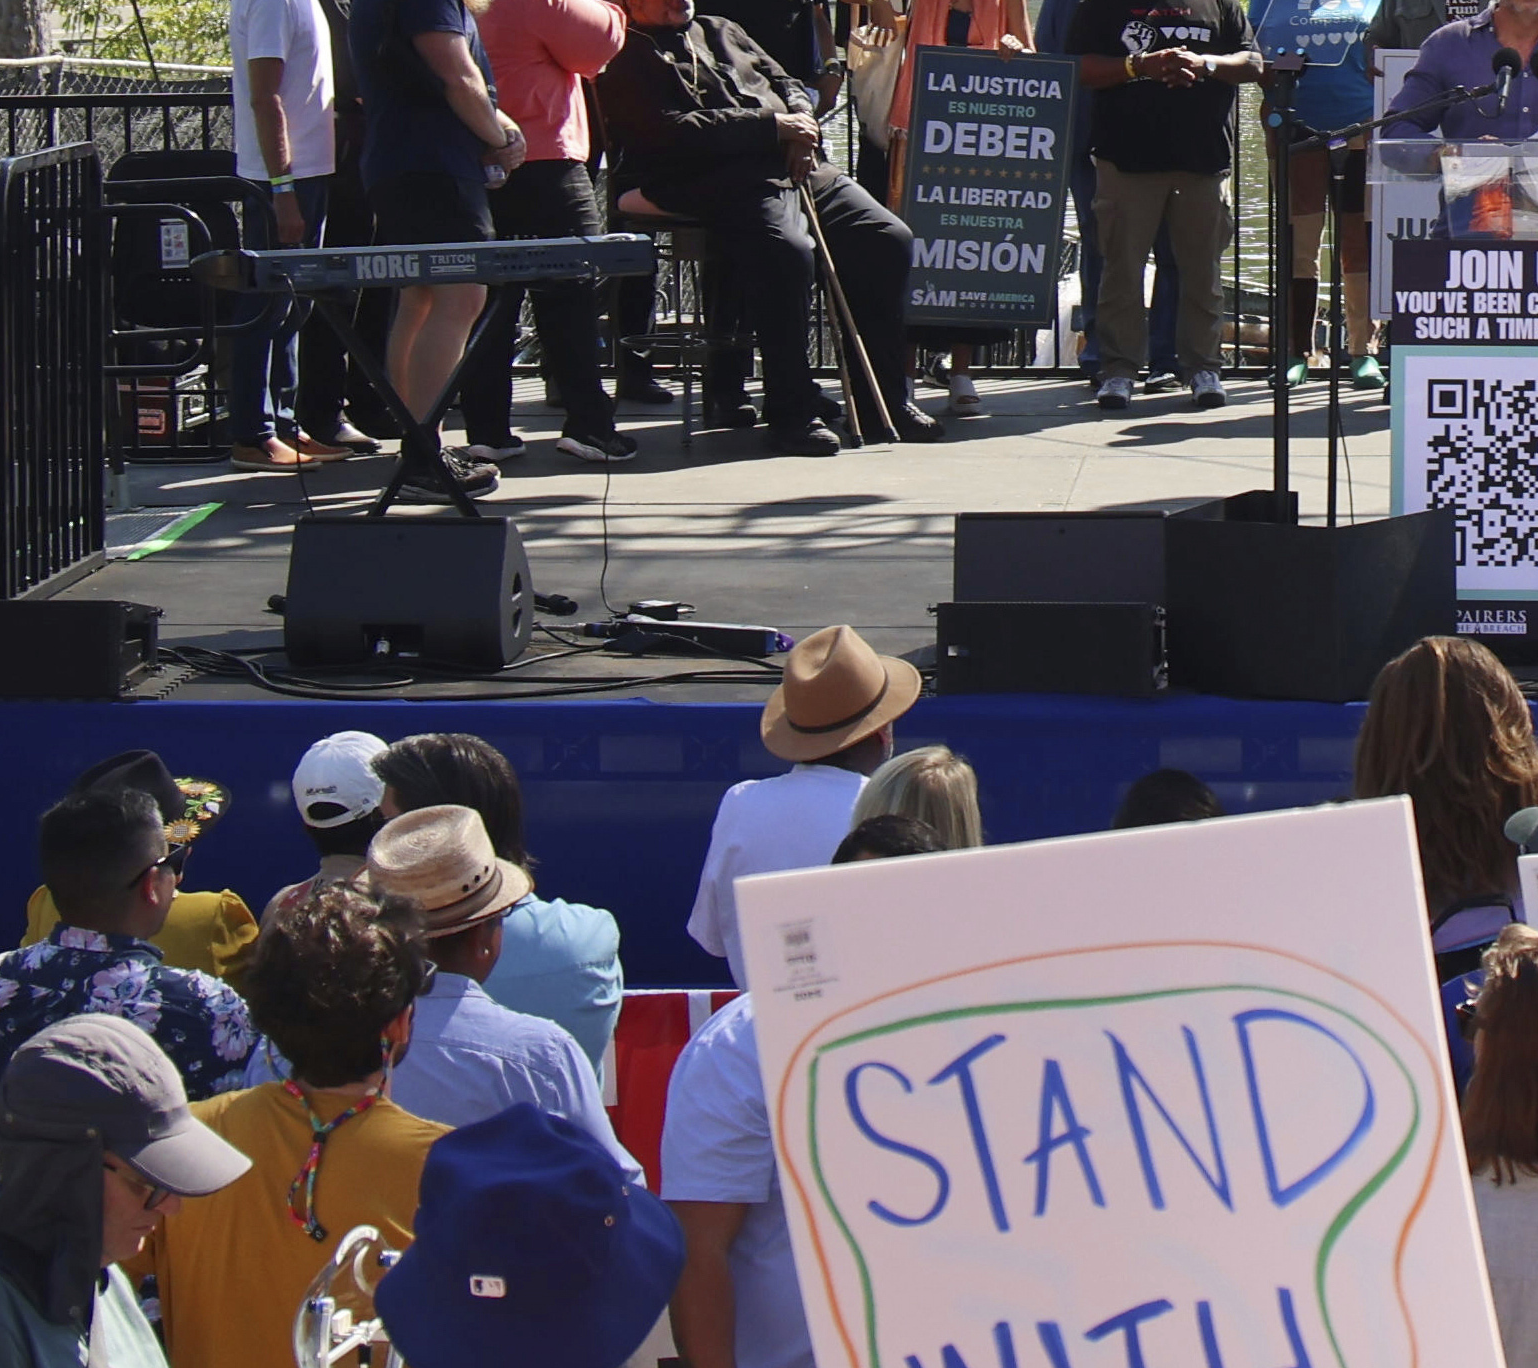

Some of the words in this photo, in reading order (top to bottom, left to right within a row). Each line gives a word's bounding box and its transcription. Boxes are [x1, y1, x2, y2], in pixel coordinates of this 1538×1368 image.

[1160, 27, 1211, 43] VOTE
[928, 72, 956, 95] LA
[961, 74, 1062, 100] JUSTICIA
[948, 101, 967, 115] ES
[969, 102, 1036, 118] NUESTRO
[923, 120, 1056, 161] DEBER
[916, 185, 943, 204] LA
[948, 187, 1052, 210] LIBERTAD
[940, 214, 958, 228] ES
[961, 215, 1024, 231] NUESTRA
[911, 234, 1045, 274] MISIÓN
[355, 254, 419, 280] KORG
[430, 254, 476, 265] TRITON
[1445, 250, 1524, 290] JOIN
[911, 288, 957, 307] SAM
[959, 292, 987, 301] SAVE
[988, 293, 1035, 303] AMERICA
[1396, 291, 1467, 314] YOU'VE
[1473, 292, 1521, 314] BEEN
[1415, 316, 1470, 340] SUCH
[1476, 318, 1490, 340] A
[845, 1006, 1375, 1231] STAND
